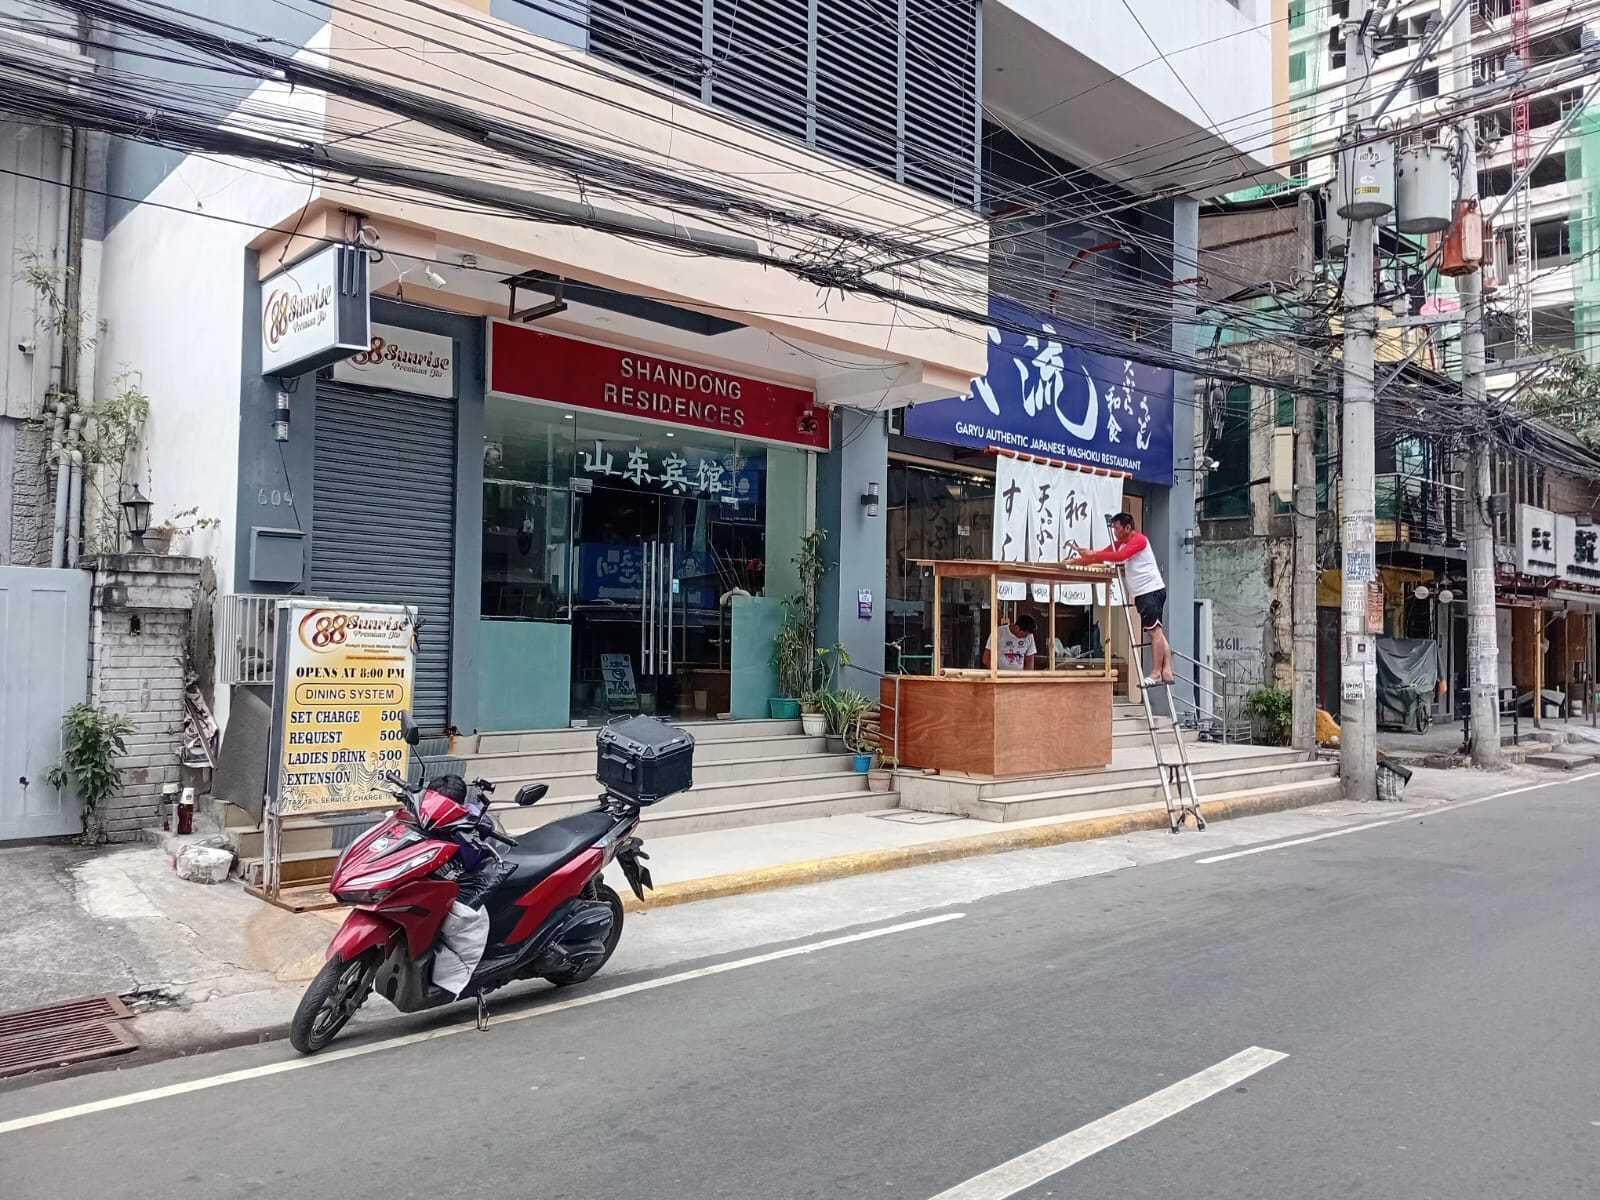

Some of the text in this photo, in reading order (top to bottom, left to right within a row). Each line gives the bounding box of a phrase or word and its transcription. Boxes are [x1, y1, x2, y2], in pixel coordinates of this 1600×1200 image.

[288, 283, 332, 322] Sunrise
[384, 344, 450, 370] Sunrise
[620, 358, 742, 400] SHANDONG
[603, 384, 745, 427] RESIDENCES
[955, 422, 1141, 470] GARYU AUTHENTIC JAPANESE WASHOKU RESTAURANT
[583, 440, 727, 494] 山东宾馆
[312, 614, 407, 647] 88 Sunrise
[1215, 637, 1240, 651] #611
[296, 667, 405, 679] OPENS AT 8:00 PM
[305, 688, 394, 700] DINING SYSTEM
[290, 710, 403, 724] SET CHARGE 500
[289, 730, 403, 744] REQUEST 500
[288, 750, 402, 765] LADIES DRINK 500
[287, 771, 350, 786] EXTENSION
